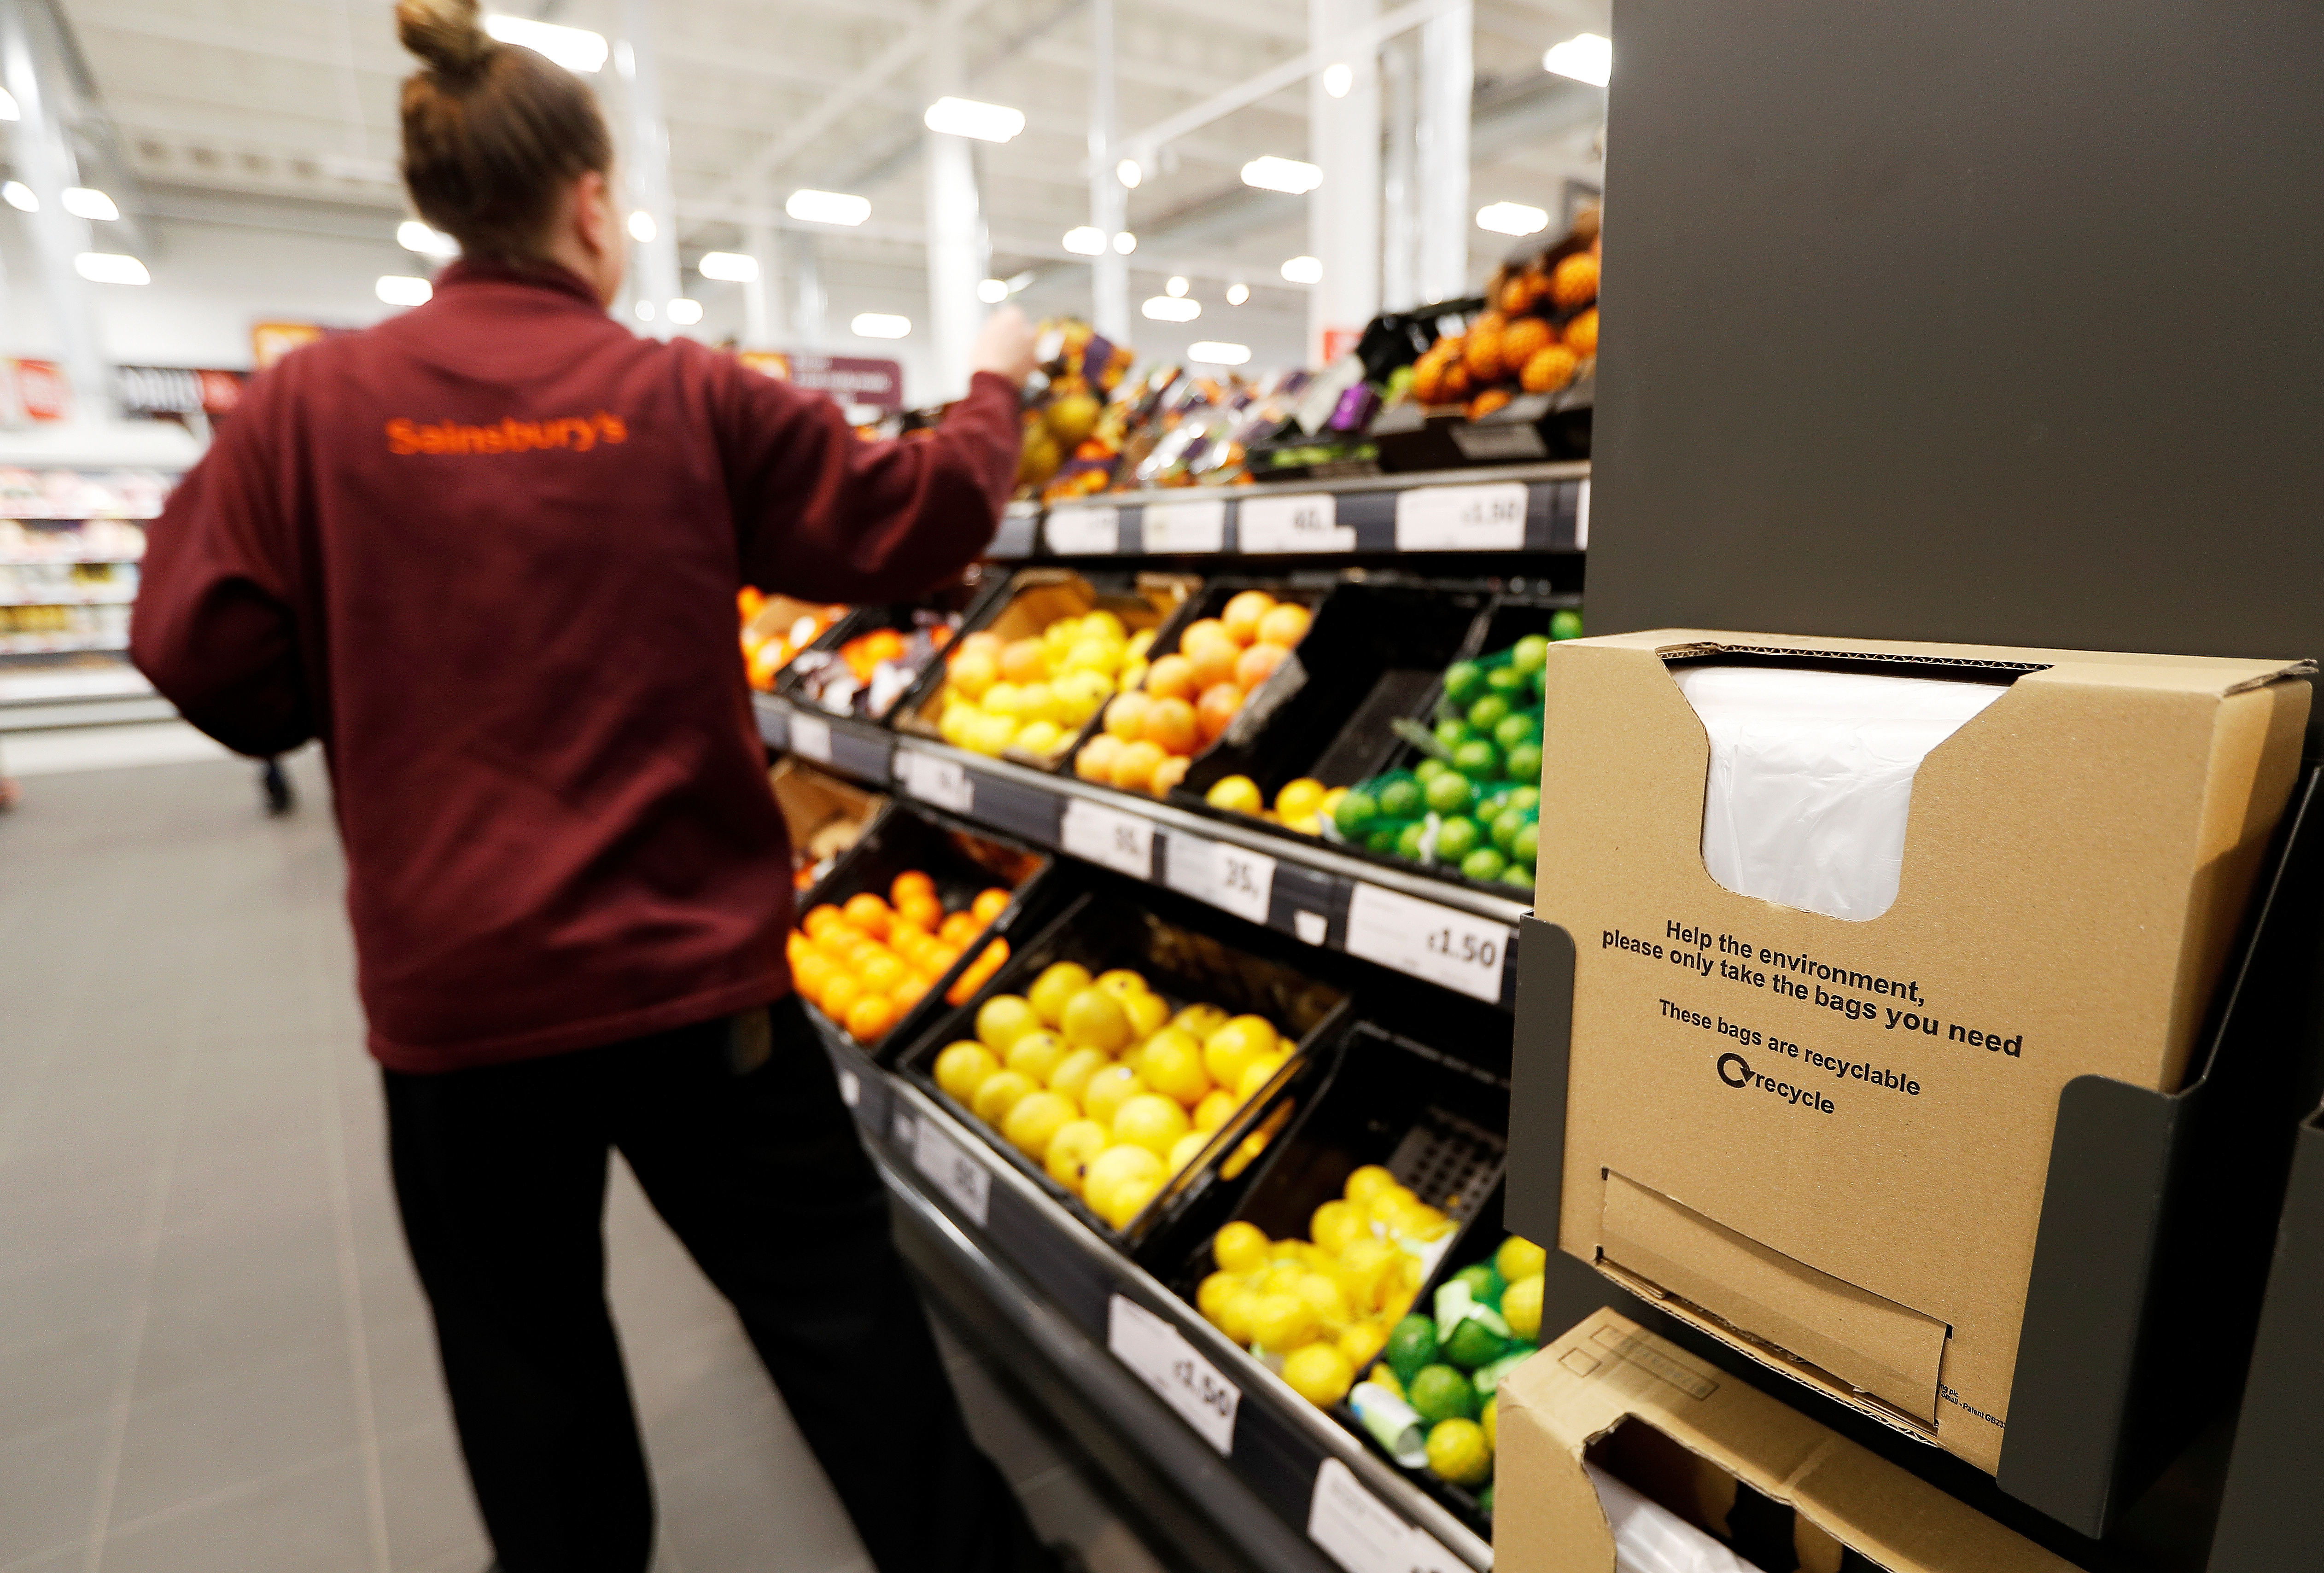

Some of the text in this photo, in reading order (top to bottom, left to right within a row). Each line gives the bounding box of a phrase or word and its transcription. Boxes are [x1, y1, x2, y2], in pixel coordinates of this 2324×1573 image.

[384, 411, 627, 454] Sainsbury's
[1428, 929, 1496, 969] £1.50
[1666, 920, 1924, 1008] Help the environment,
[1602, 929, 2023, 1058] please only take the bags you need
[1659, 998, 1920, 1096] These bags are recyclable
[1755, 1073, 1835, 1114] recycle
[1941, 1390, 1958, 1405] Small
[1963, 1403, 1984, 1419] Patent
